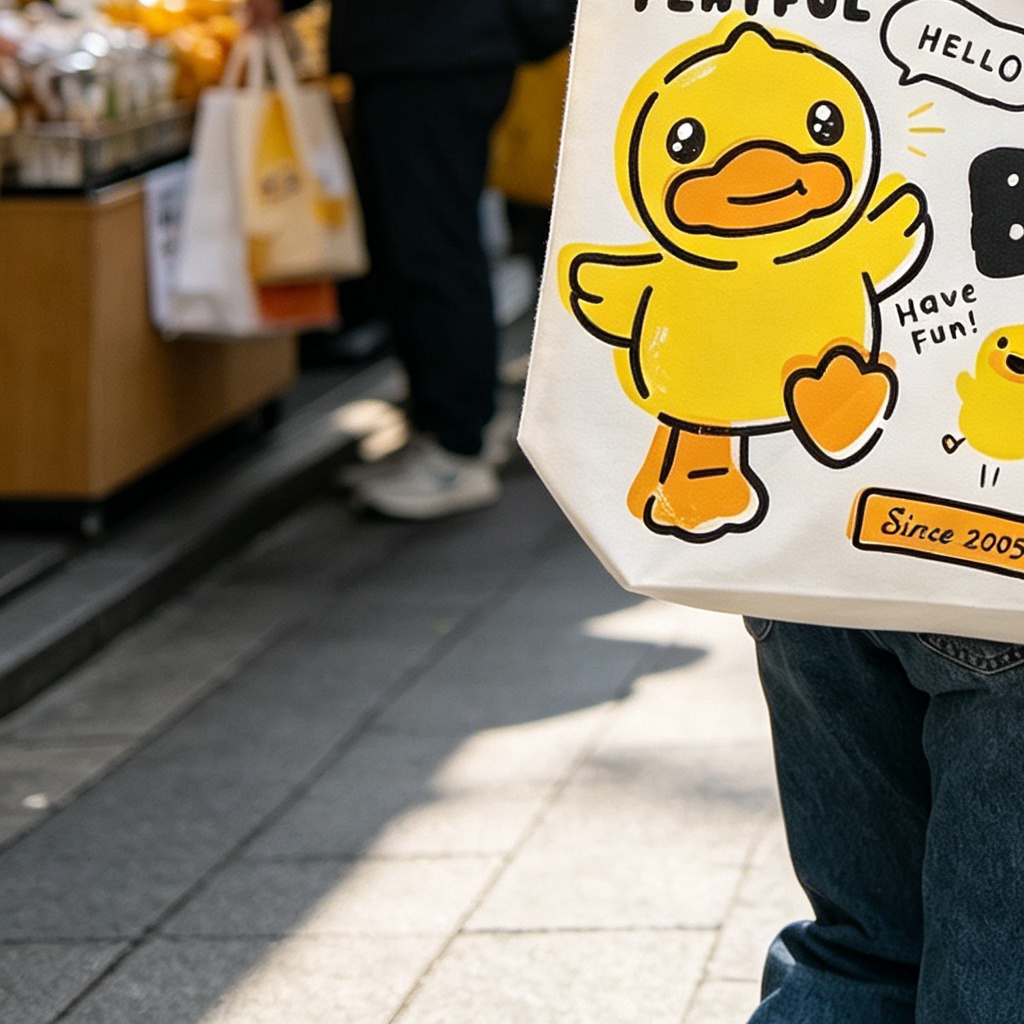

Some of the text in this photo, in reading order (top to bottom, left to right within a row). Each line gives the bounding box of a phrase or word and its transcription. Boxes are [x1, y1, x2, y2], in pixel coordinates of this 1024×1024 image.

[918, 24, 1022, 82] HELLO
[895, 284, 977, 327] Have
[911, 310, 977, 355] Fun!
[881, 507, 954, 544] Since
